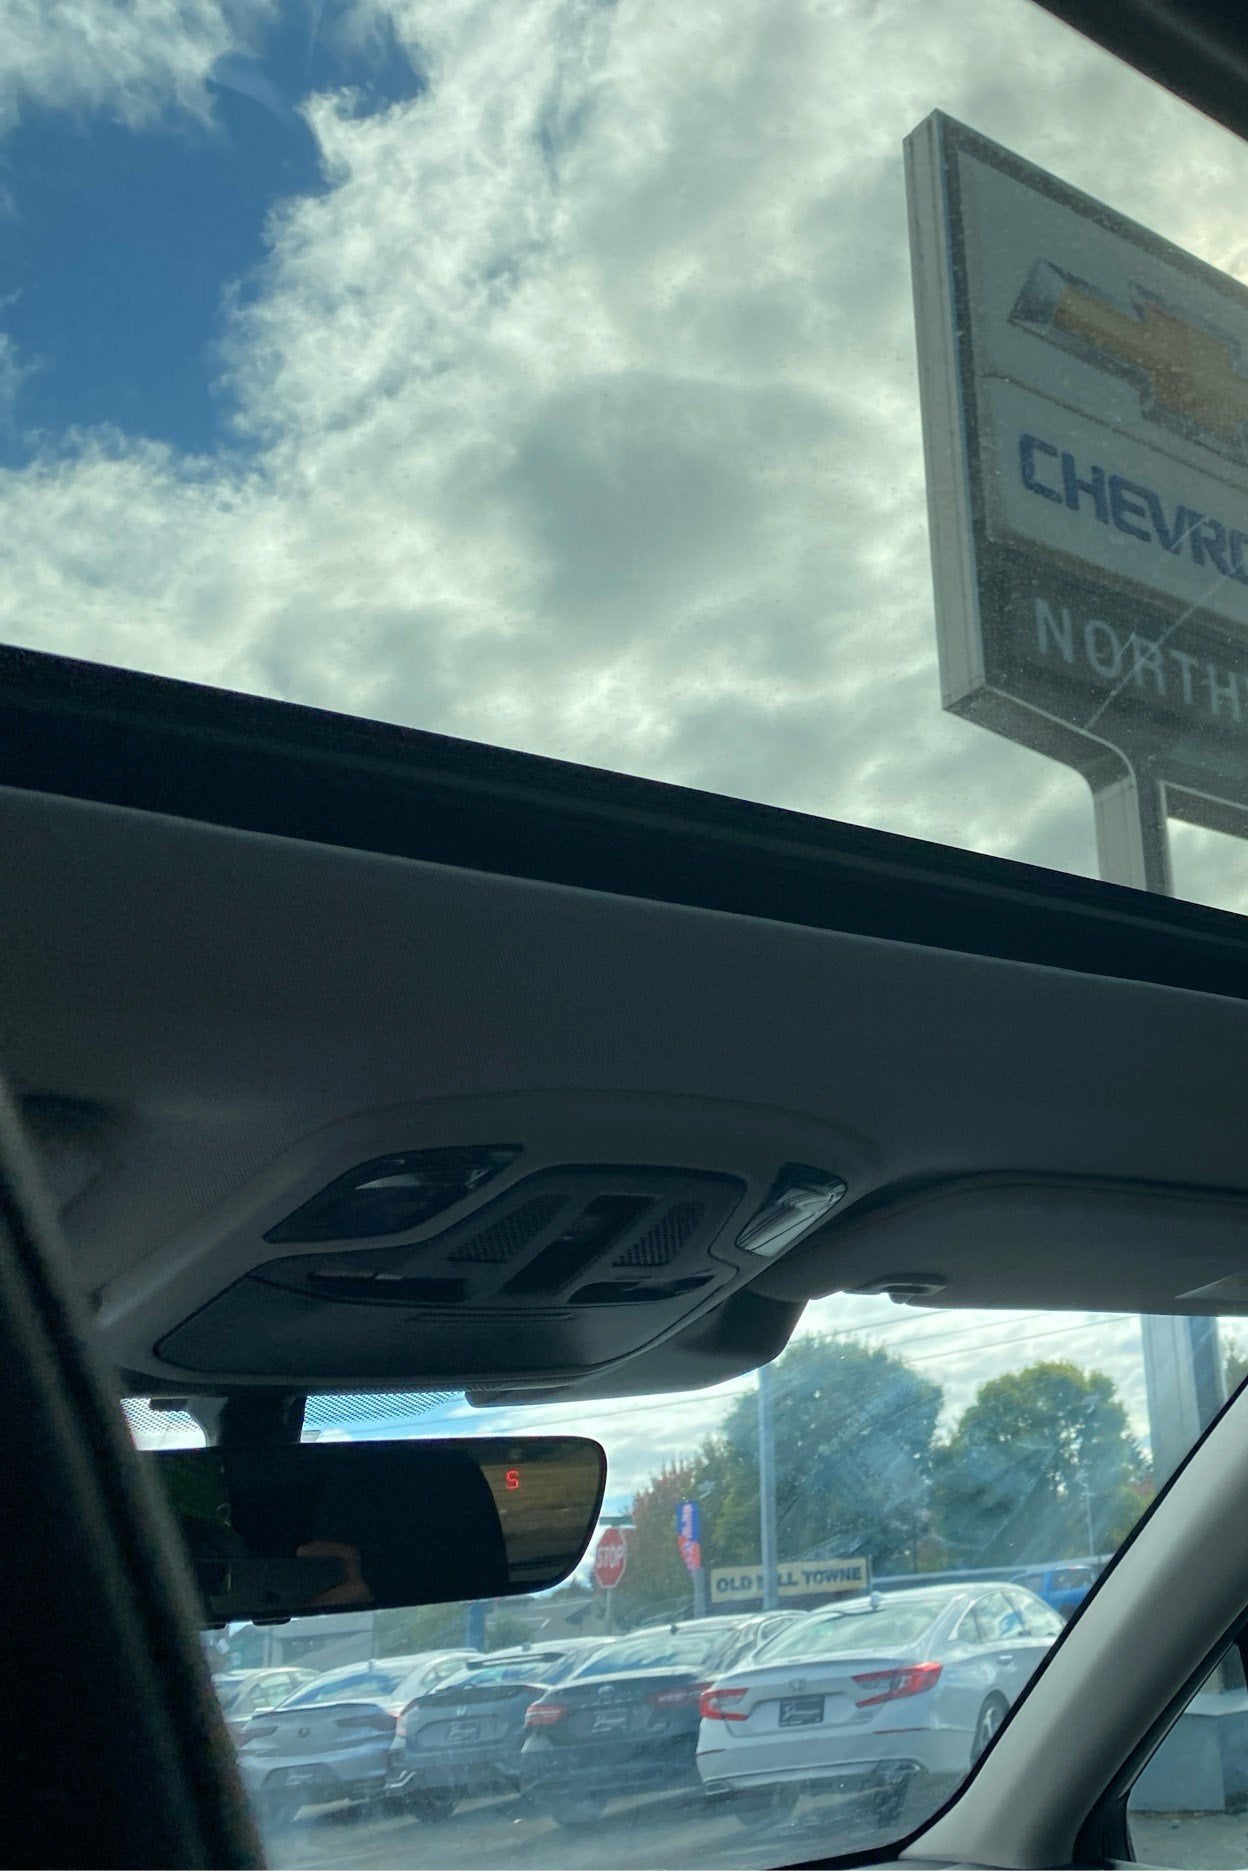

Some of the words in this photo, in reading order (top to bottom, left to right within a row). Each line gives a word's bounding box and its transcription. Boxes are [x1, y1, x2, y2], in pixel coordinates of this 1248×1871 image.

[596, 1543, 625, 1569] STOP
[716, 1575, 753, 1592] OLD
[757, 1571, 798, 1590] LL
[802, 1566, 862, 1586] TOWNE
